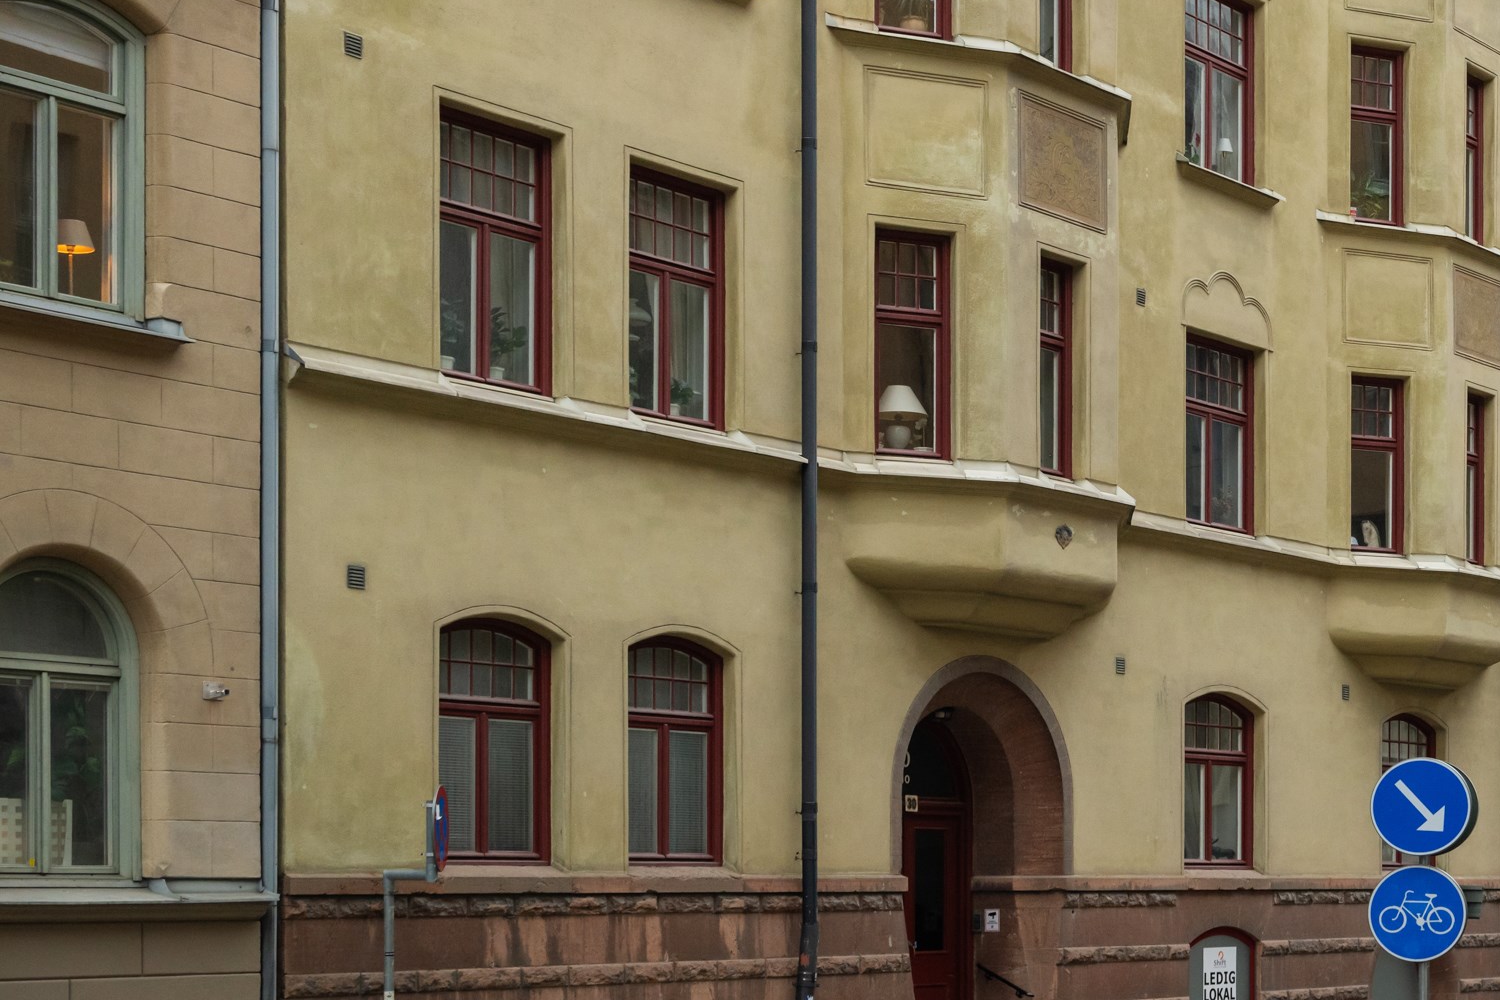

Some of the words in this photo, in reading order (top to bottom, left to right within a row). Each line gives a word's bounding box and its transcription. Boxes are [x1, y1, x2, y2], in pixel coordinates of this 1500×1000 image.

[907, 797, 917, 810] 30
[1204, 970, 1236, 986] LEDIG
[1204, 987, 1236, 1000] LOKAL
